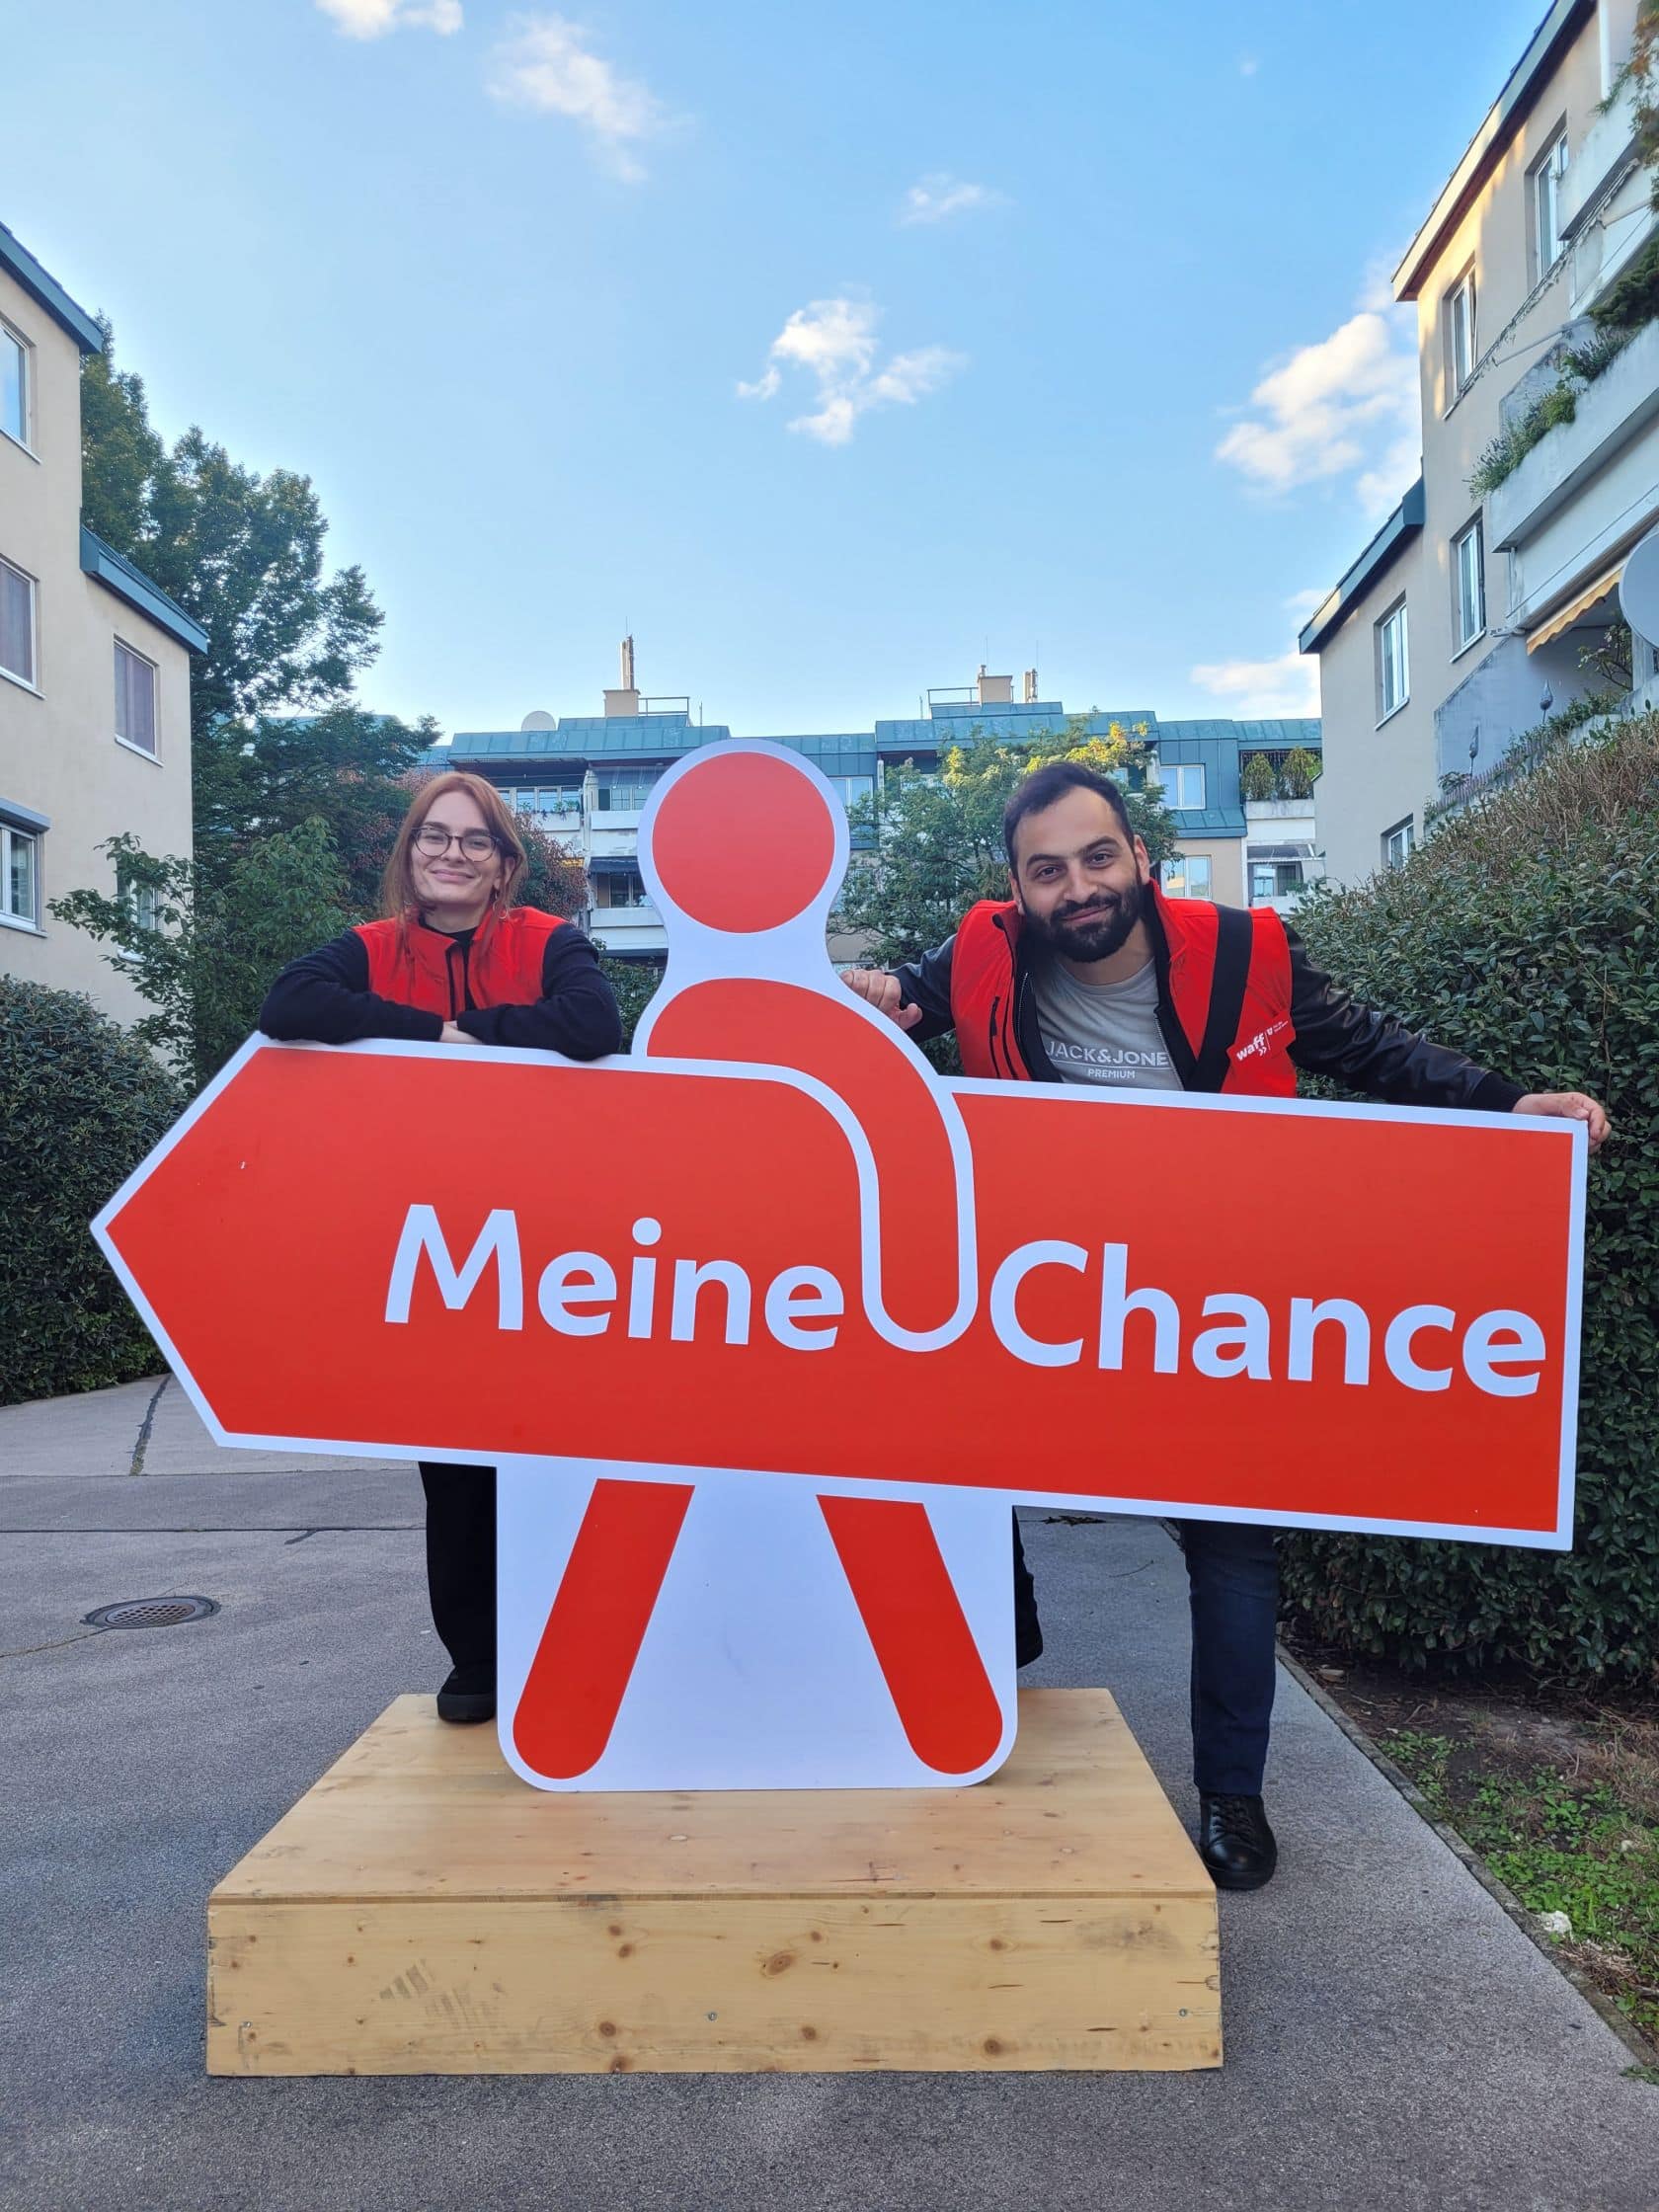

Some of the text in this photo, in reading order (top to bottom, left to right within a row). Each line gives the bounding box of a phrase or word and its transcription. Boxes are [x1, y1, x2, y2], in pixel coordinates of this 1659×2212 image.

[1047, 1041, 1169, 1066] JACK&JONE
[1236, 1032, 1265, 1061] waff
[1087, 1067, 1136, 1079] PREMIUM
[384, 1203, 1547, 1398] Meine Chance
